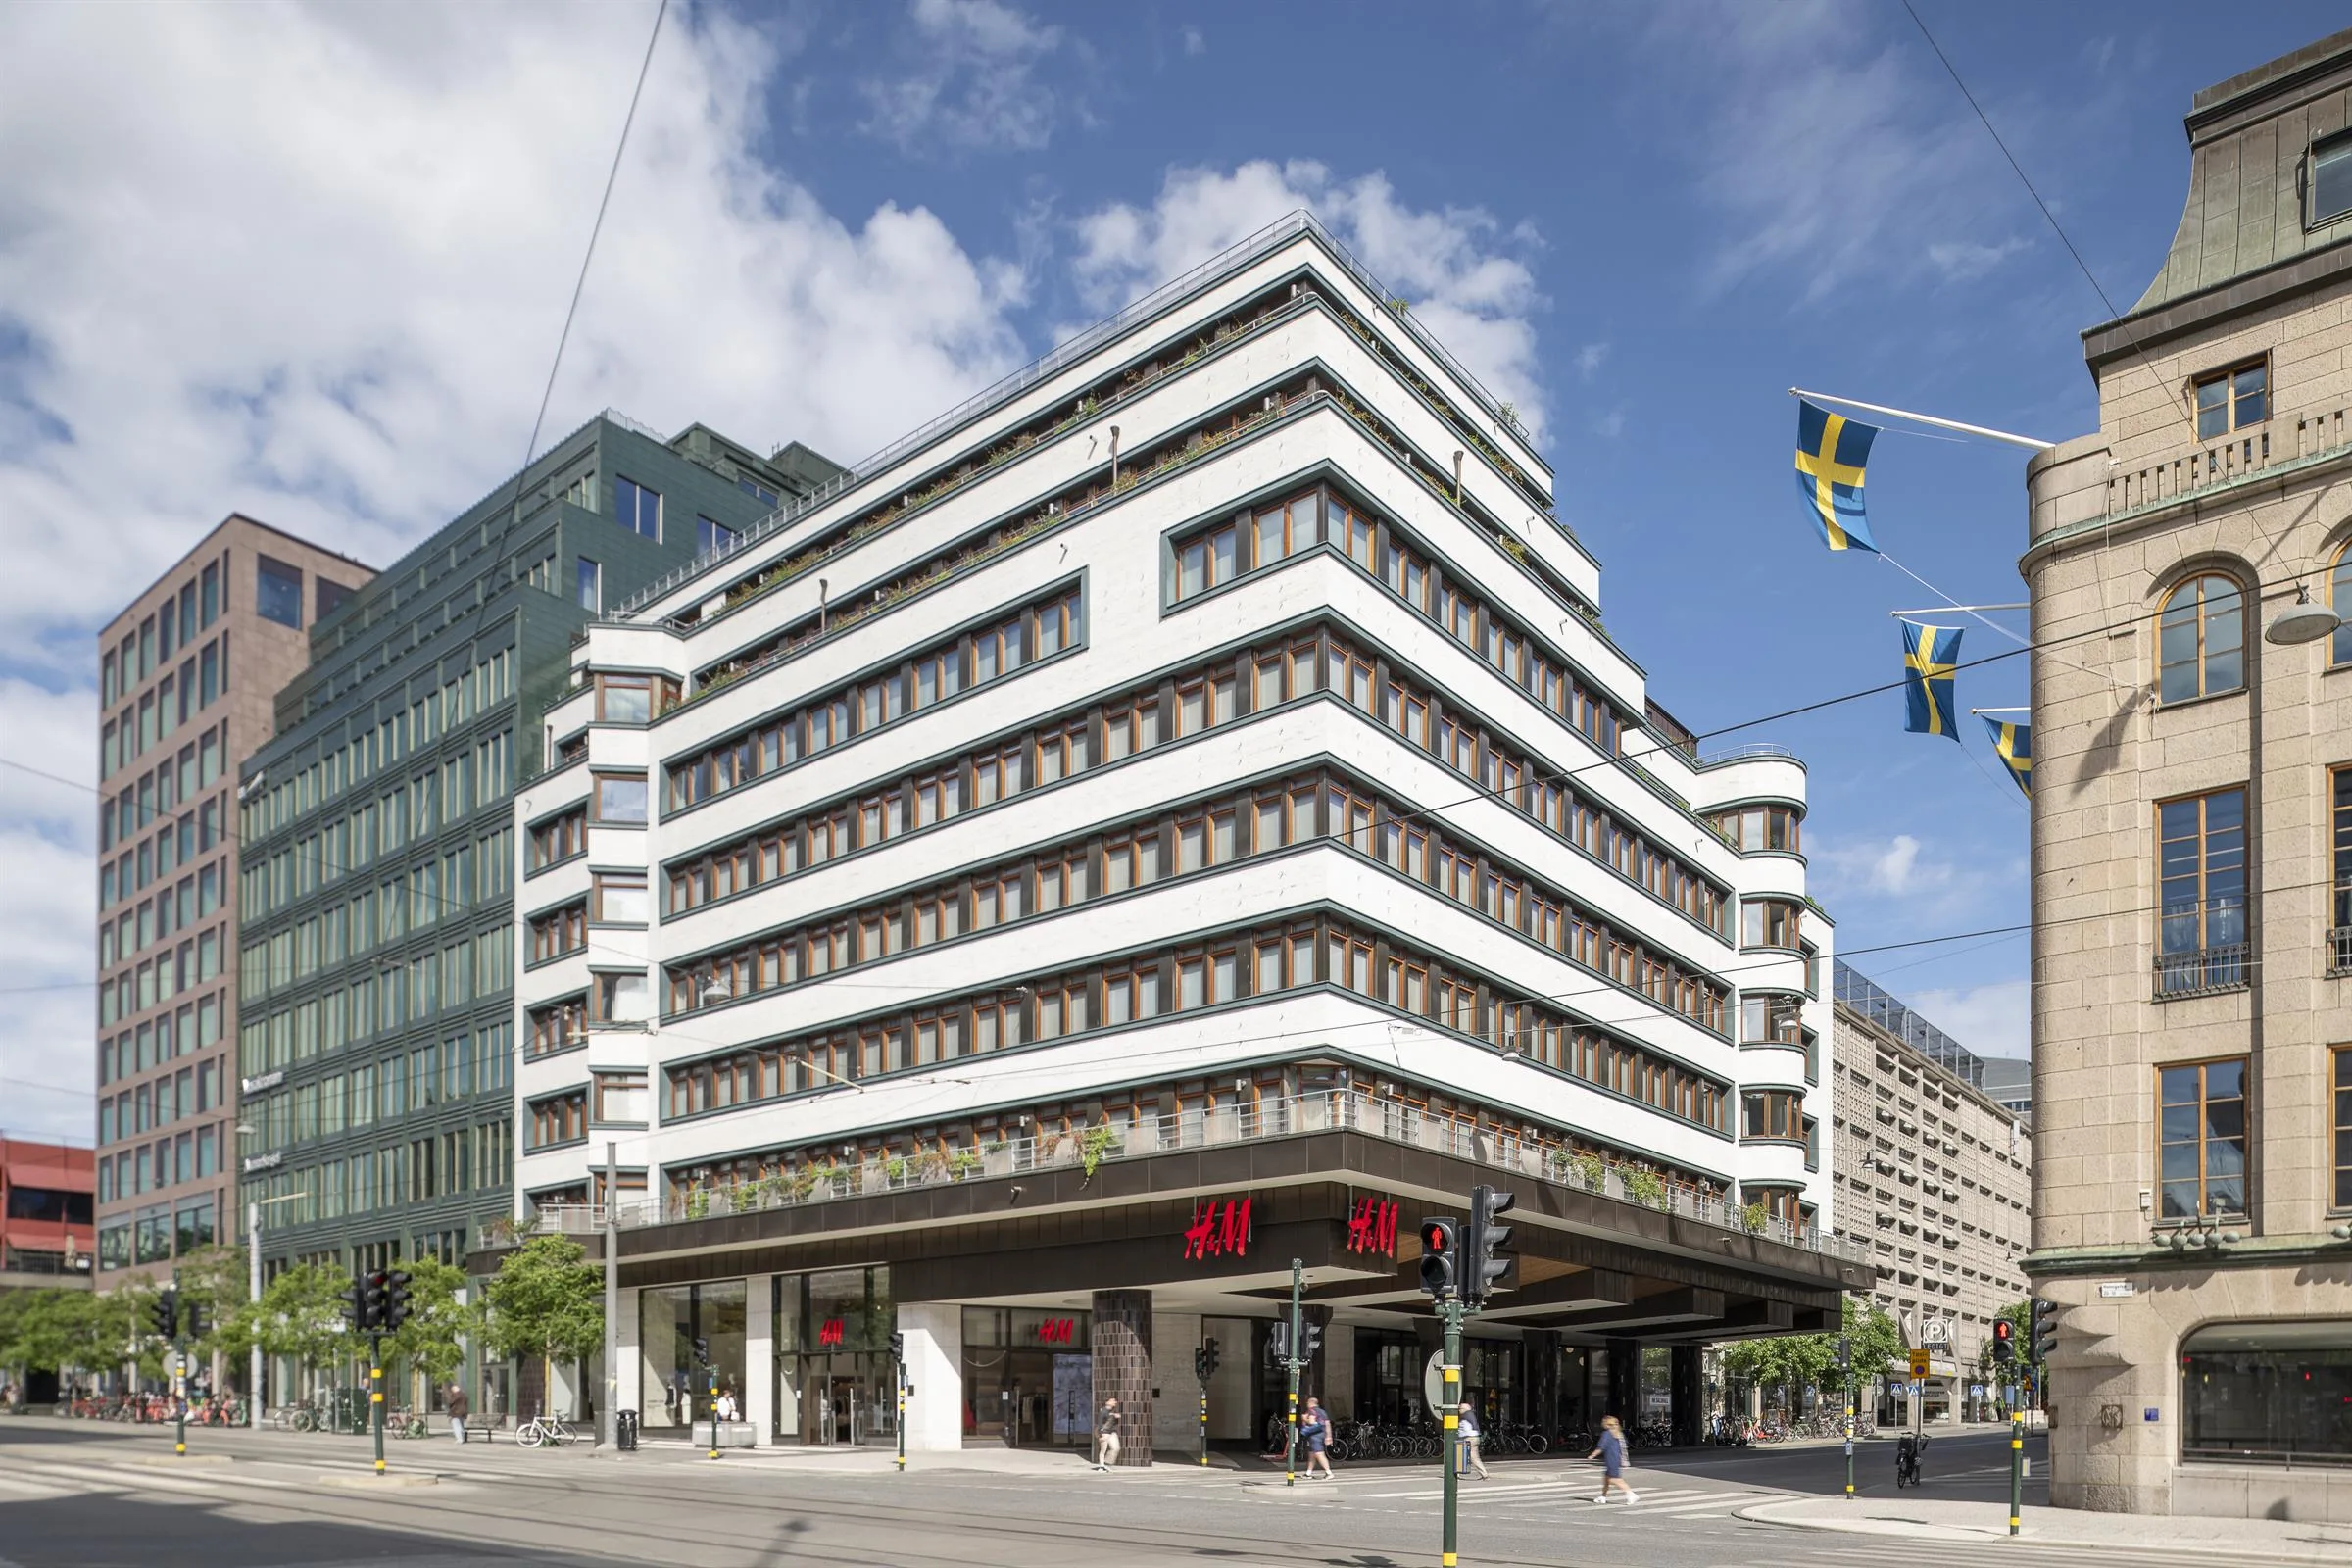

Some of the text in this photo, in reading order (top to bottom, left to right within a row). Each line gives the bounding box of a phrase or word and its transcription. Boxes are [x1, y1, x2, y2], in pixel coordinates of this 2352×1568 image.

[1184, 1197, 1252, 1261] H&M
[1348, 1197, 1398, 1258] H&M
[1039, 1317, 1073, 1344] H&M
